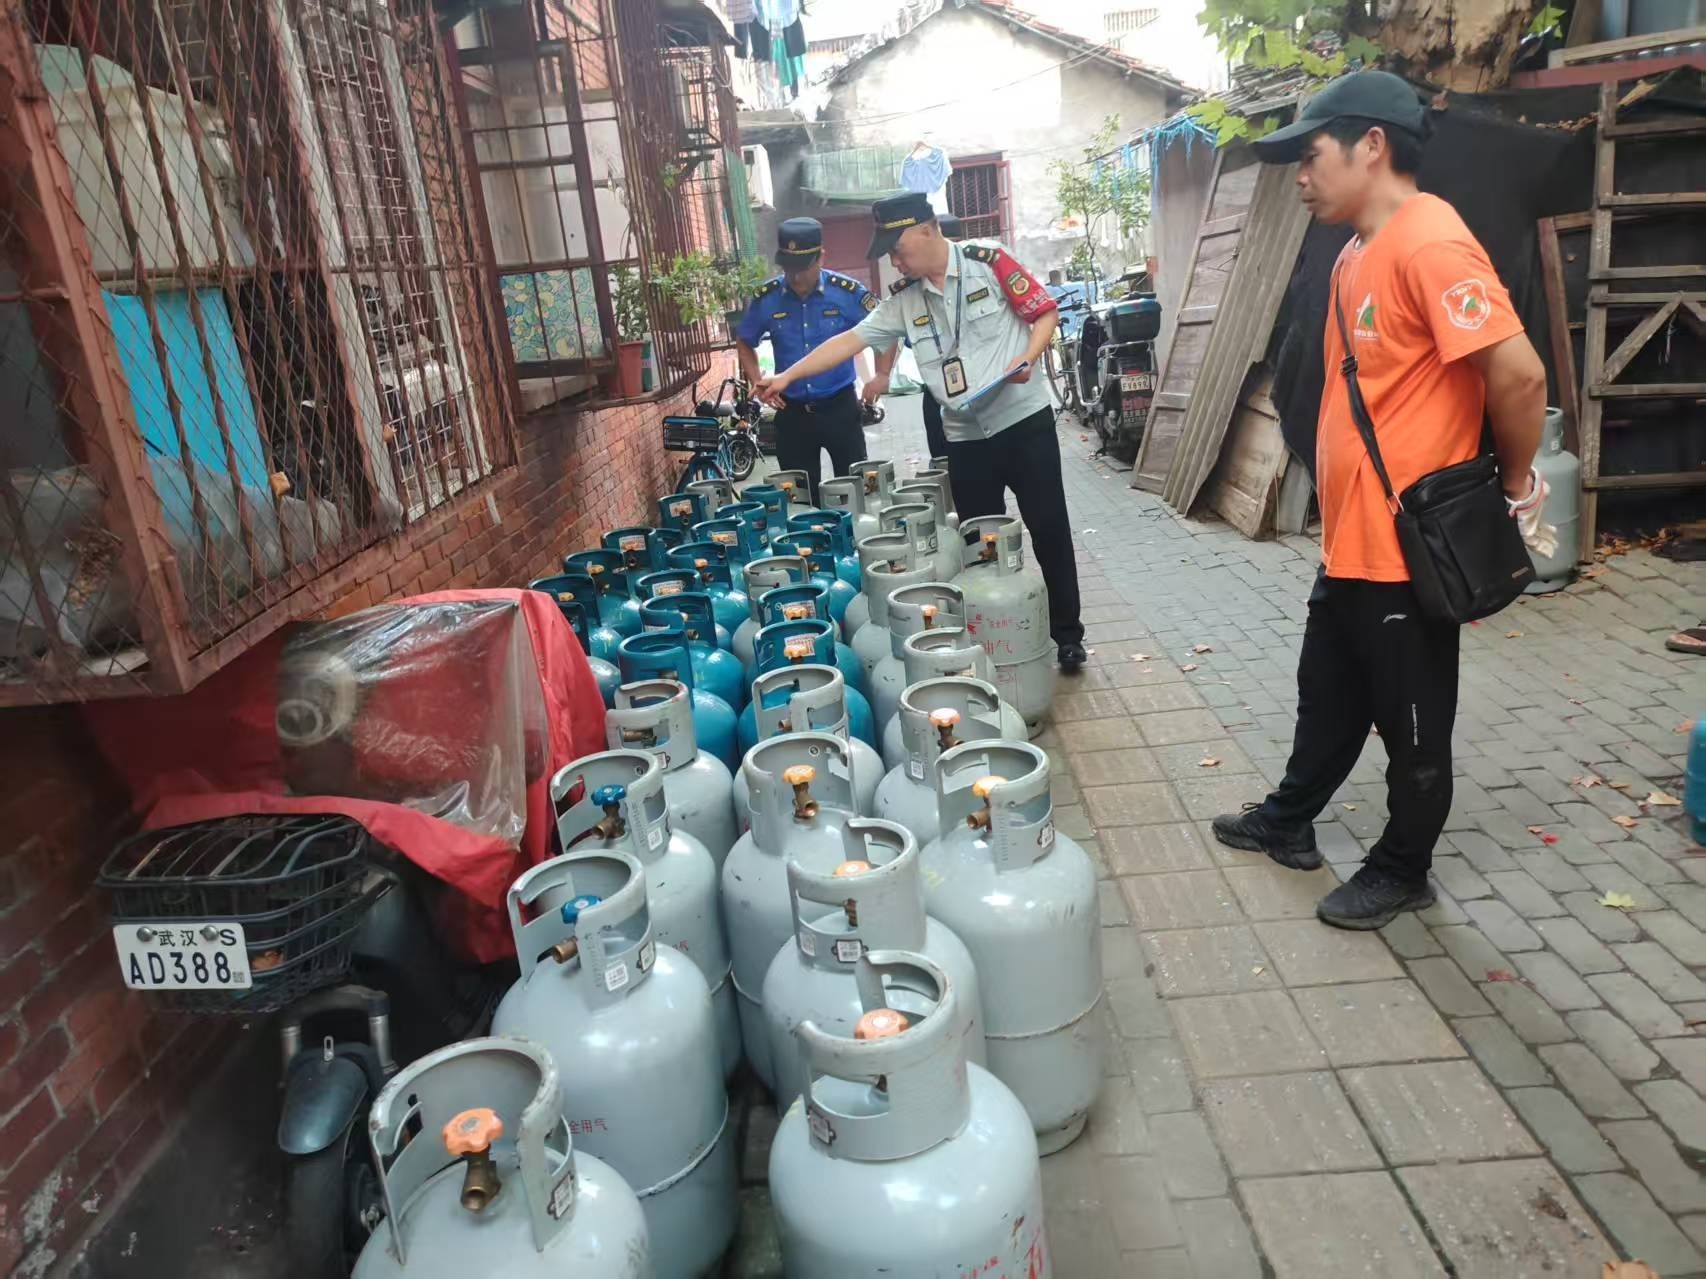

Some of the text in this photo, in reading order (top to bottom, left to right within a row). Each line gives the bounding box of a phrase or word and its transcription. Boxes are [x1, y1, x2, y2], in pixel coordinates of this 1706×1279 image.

[158, 929, 237, 947] 武汉 S
[130, 952, 231, 985] AD388
